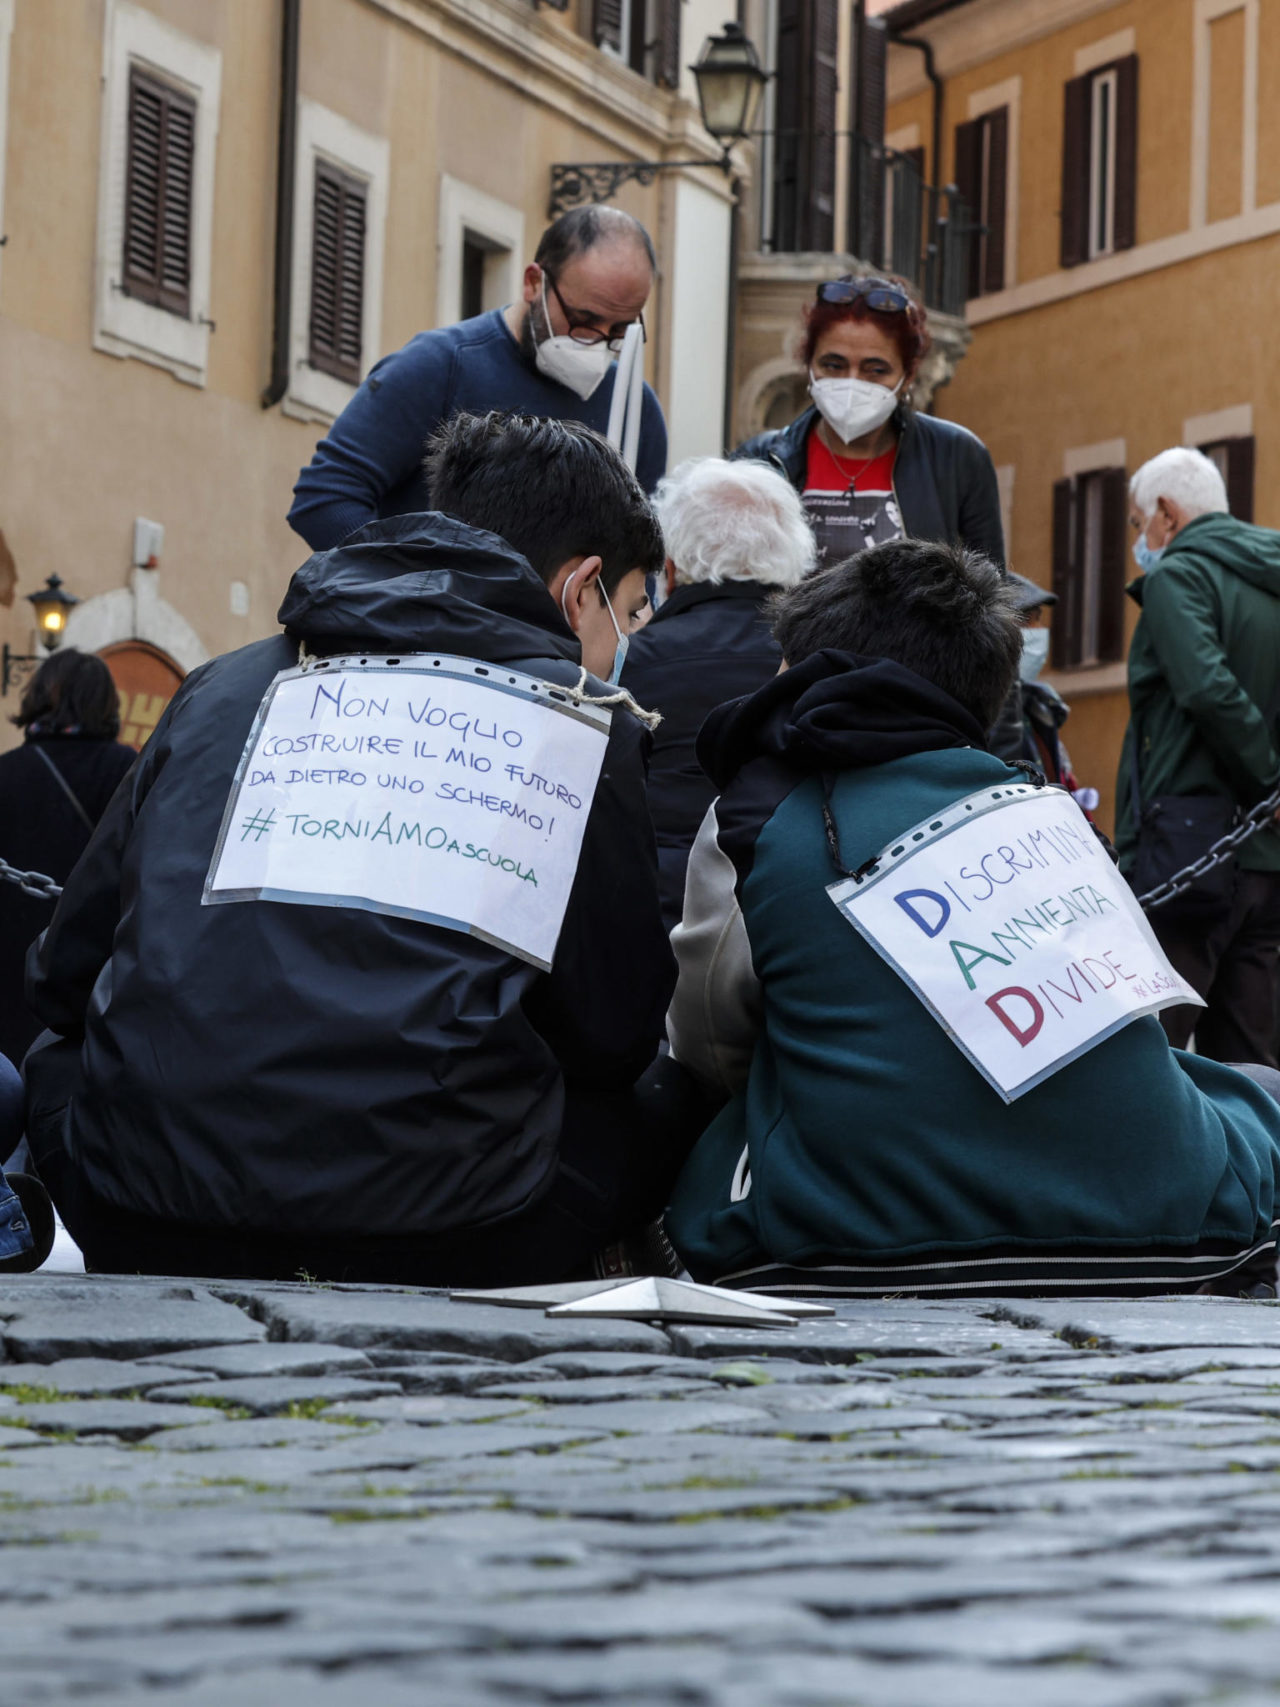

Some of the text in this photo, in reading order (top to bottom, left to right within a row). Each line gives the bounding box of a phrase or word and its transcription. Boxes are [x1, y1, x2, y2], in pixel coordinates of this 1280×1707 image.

[310, 679, 523, 748] NON VOGLIO
[248, 768, 555, 843] DA DIETRO UNO SCHERMO!
[262, 733, 583, 810] COSTRUIRE IL MIO FUTURO
[949, 884, 1119, 991] ANNIENTA
[985, 950, 1137, 1048] DIVIDE
